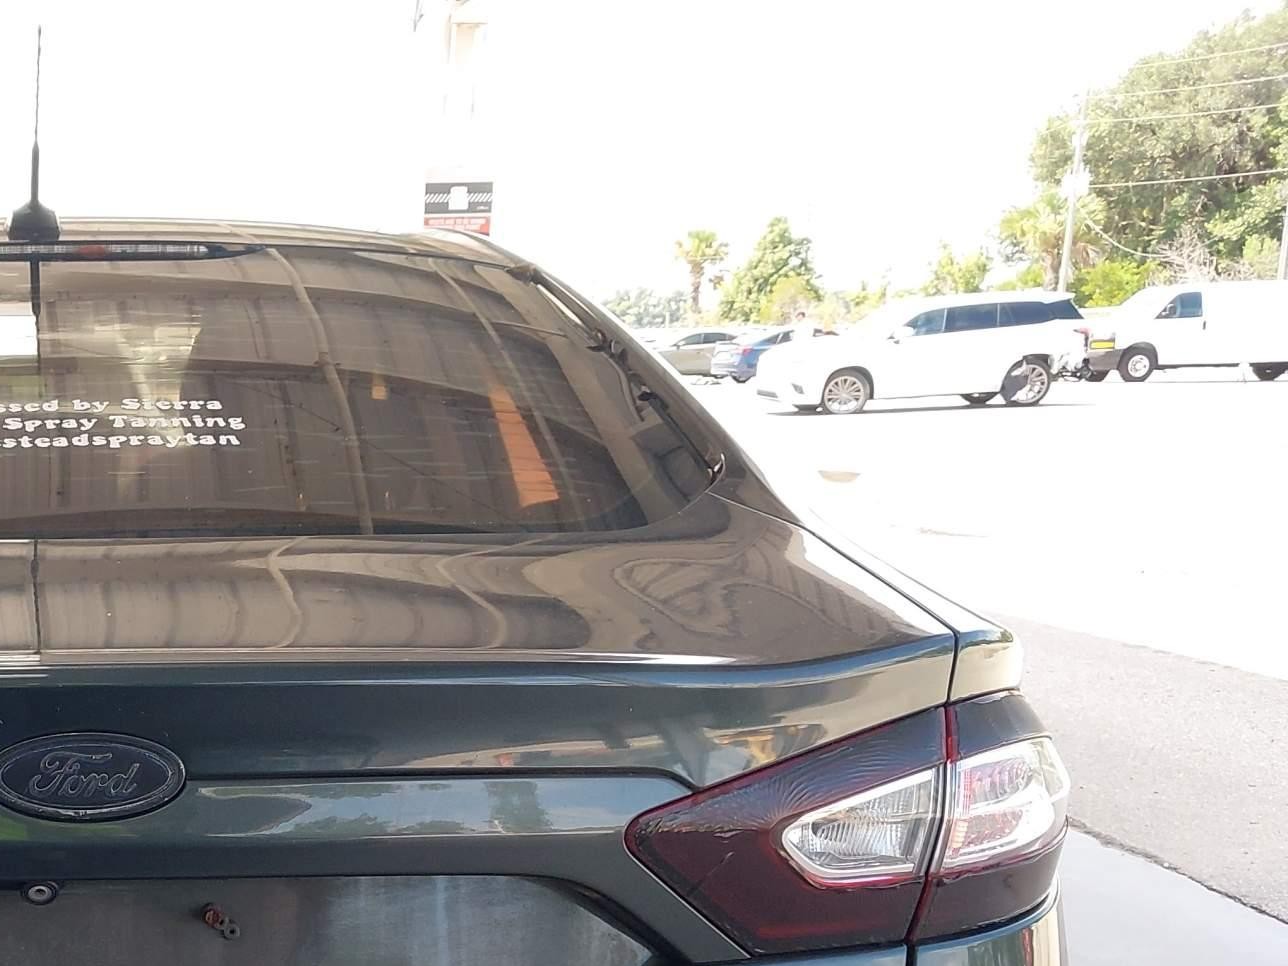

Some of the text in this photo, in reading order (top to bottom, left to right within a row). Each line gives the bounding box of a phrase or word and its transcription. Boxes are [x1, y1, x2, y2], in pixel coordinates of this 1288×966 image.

[71, 398, 110, 413] by
[120, 397, 223, 411] Sierra
[2, 417, 98, 433] Spray
[108, 414, 247, 431] Tanning
[28, 751, 141, 798] Ford
